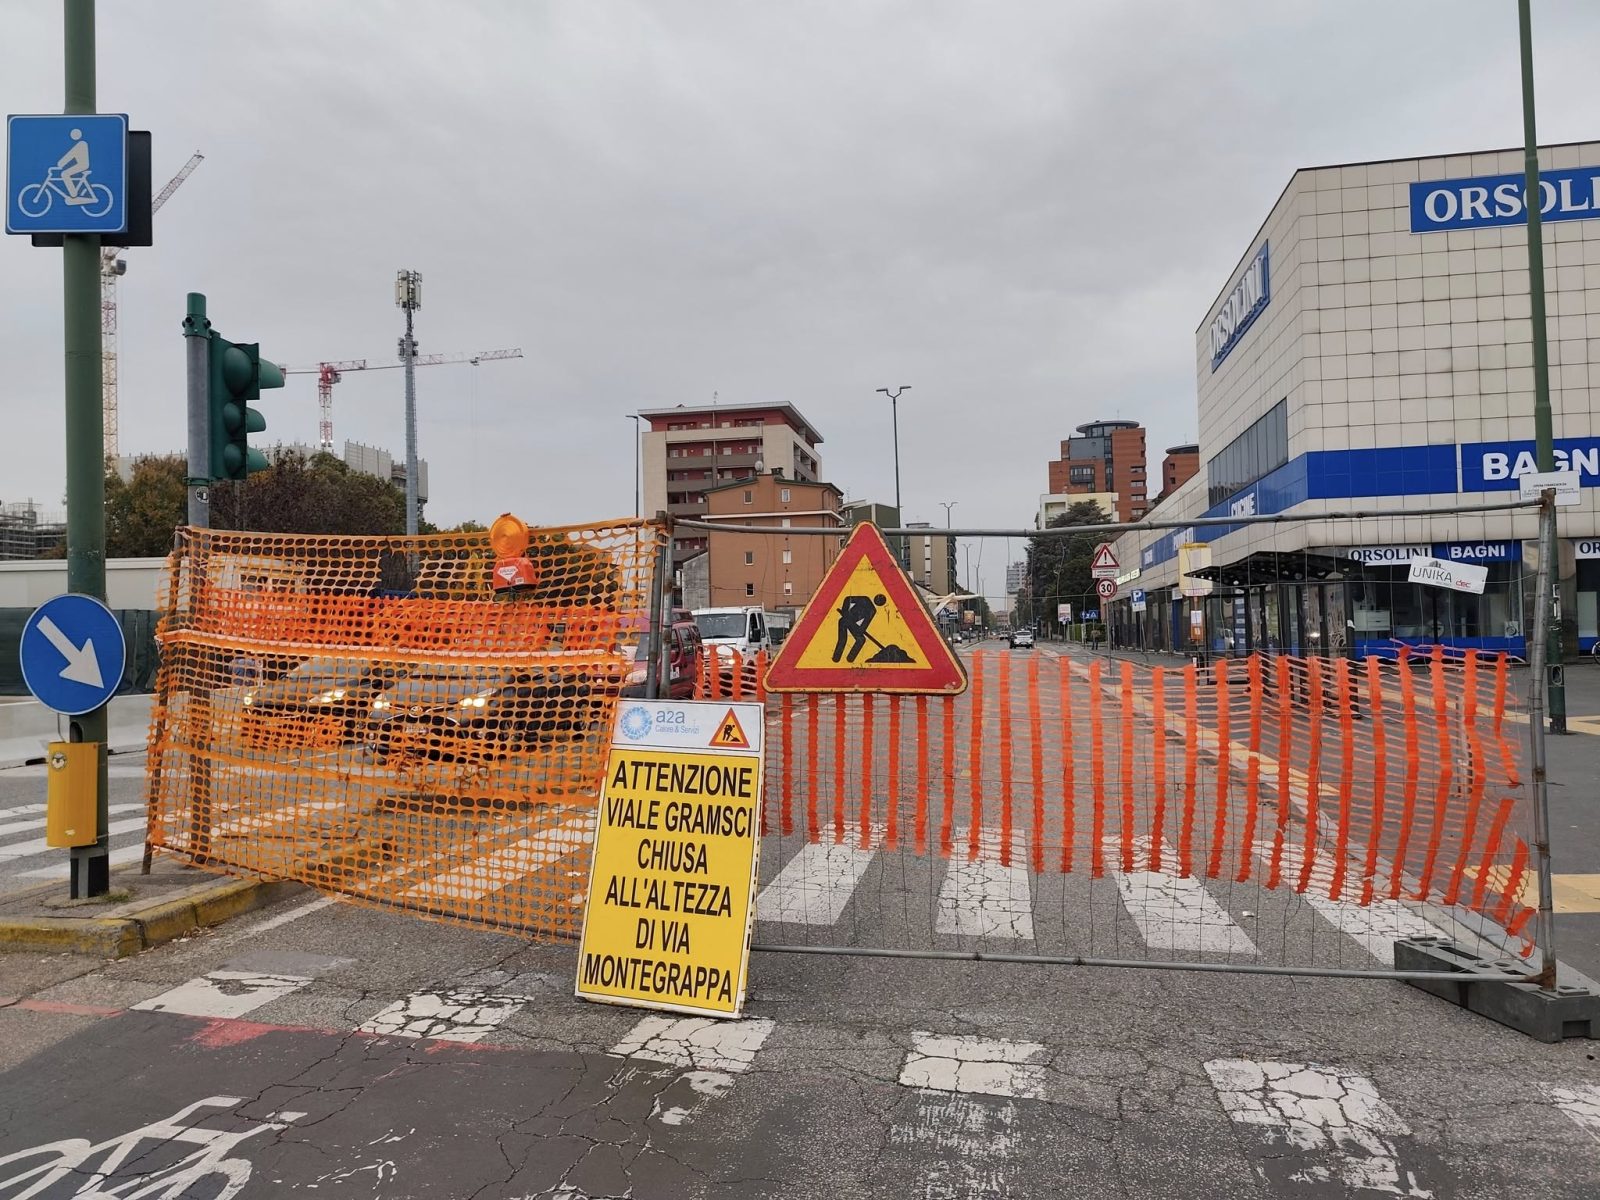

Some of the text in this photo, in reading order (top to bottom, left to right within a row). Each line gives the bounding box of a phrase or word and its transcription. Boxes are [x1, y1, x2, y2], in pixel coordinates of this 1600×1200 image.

[1210, 254, 1264, 361] ORSOLINI
[1350, 546, 1428, 561] ORSOLINI
[1450, 544, 1505, 559] BAGNI
[1100, 583, 1112, 593] 30
[1412, 566, 1452, 583] UNIKA
[1132, 591, 1142, 602] P
[655, 710, 685, 724] a2a
[655, 724, 673, 733] Calore
[680, 726, 700, 735] Servizi
[612, 760, 752, 798] ATTENZIONE
[607, 797, 753, 838] VIALE GRAMSCI
[637, 838, 708, 875] CHIUSA
[604, 875, 732, 918] ALL'ALTEZZA
[635, 917, 690, 955] DI VIA
[583, 953, 732, 1003] MONTEGRAPPA
